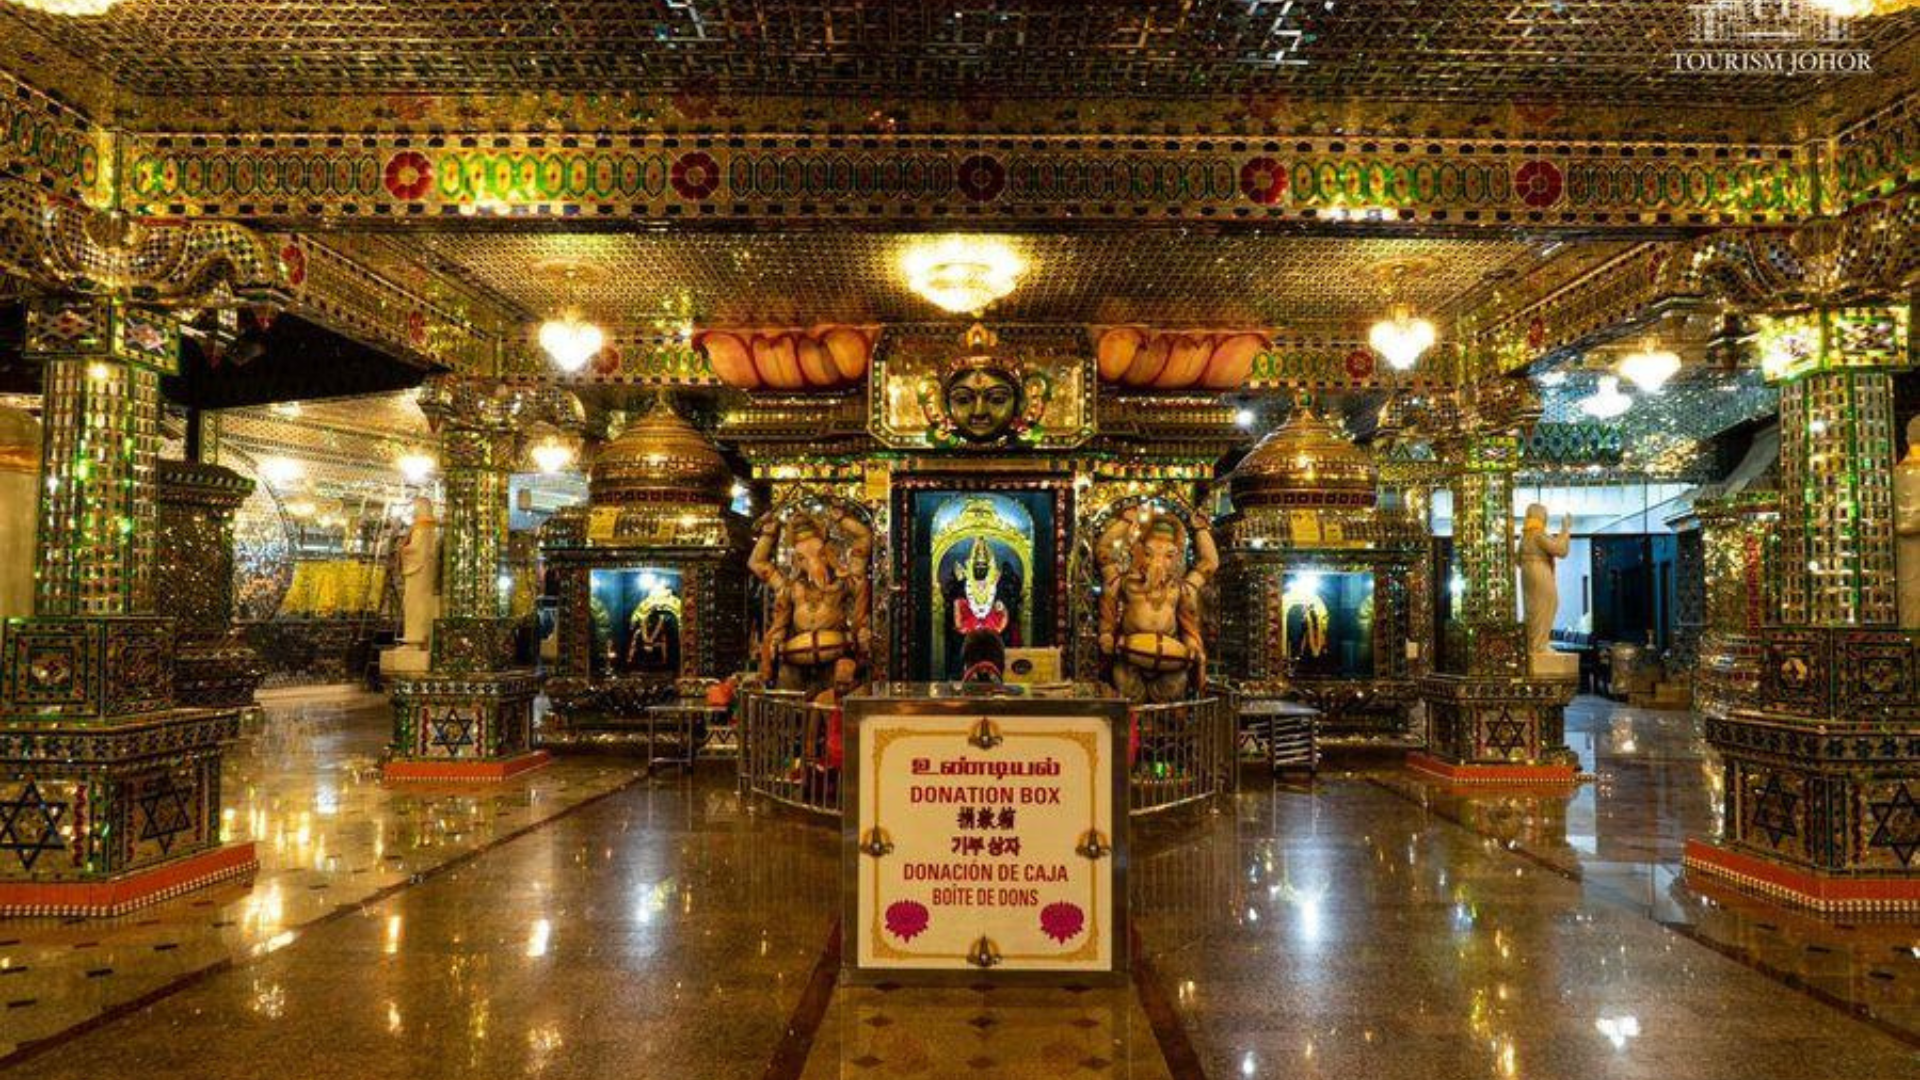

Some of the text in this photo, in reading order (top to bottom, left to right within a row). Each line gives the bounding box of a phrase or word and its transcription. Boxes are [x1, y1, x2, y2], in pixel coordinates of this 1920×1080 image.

[910, 786, 1061, 804] DONATION BOX
[951, 836, 1021, 857] 기부 상자
[903, 860, 1068, 882] DONACIÓN DE CAJA
[932, 884, 1039, 906] BOÎTE DE DONS
